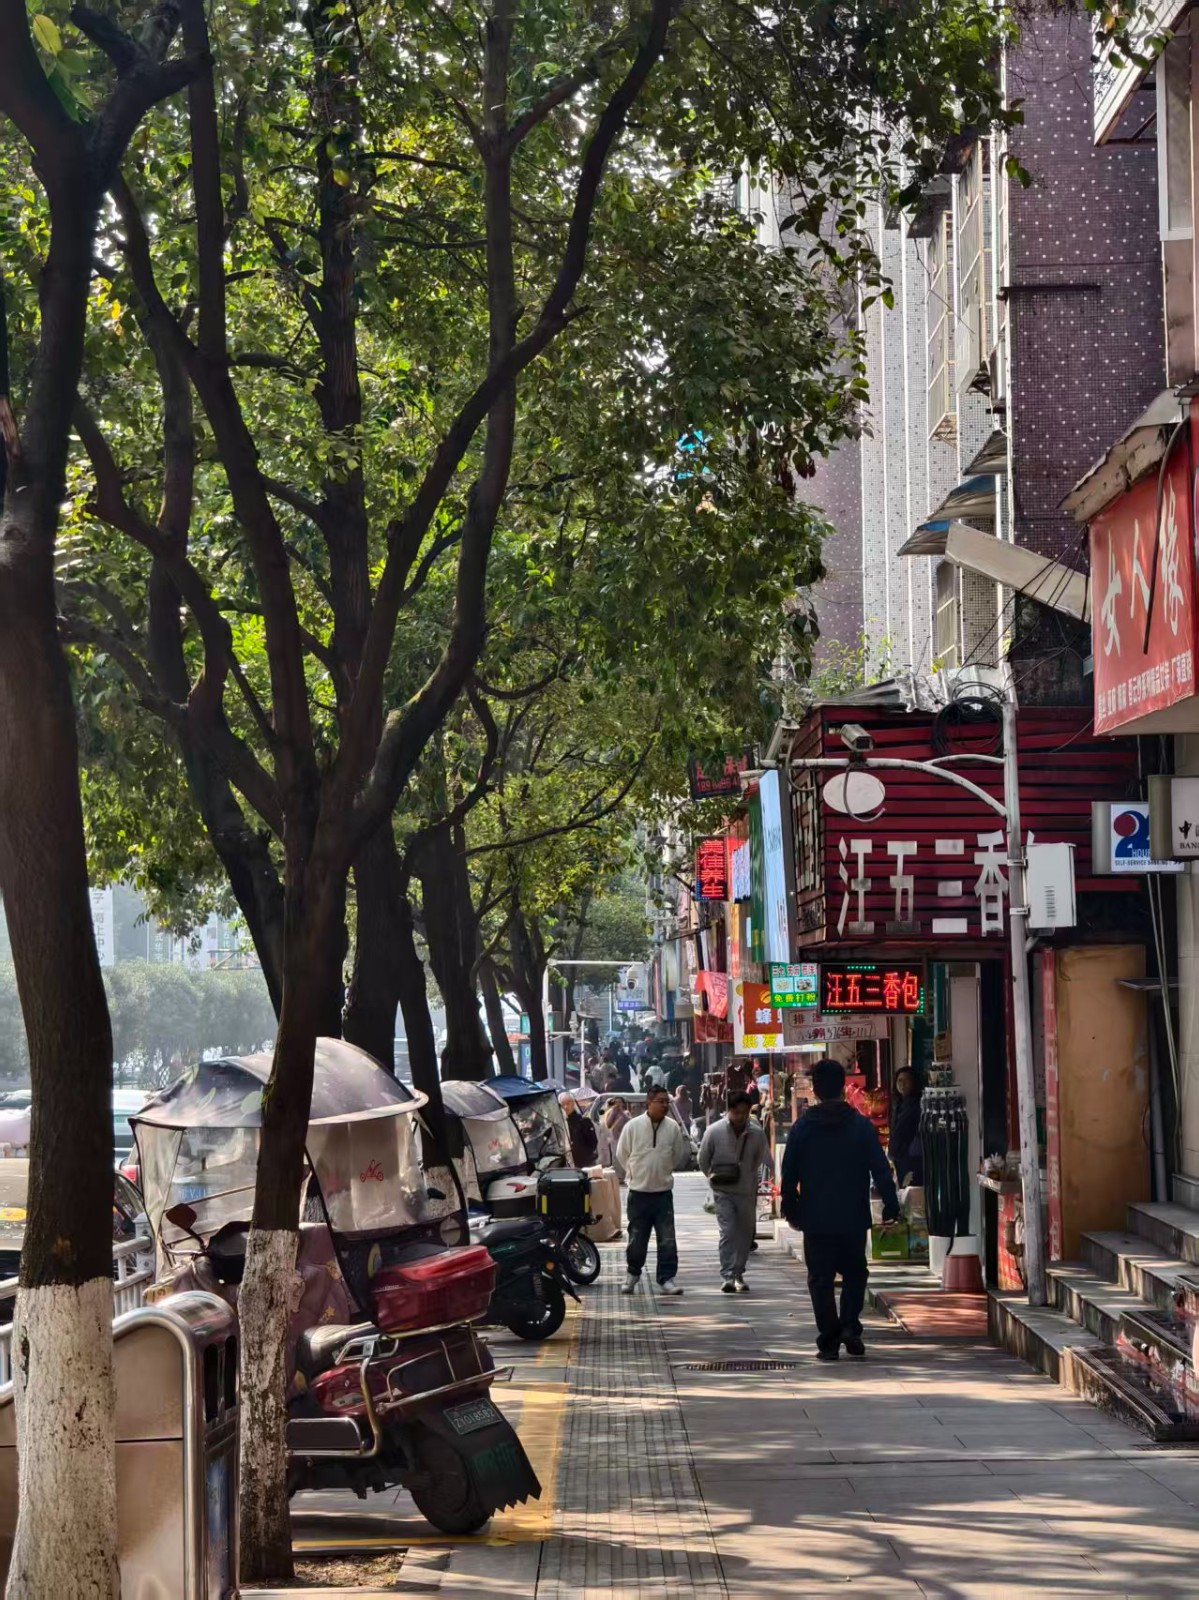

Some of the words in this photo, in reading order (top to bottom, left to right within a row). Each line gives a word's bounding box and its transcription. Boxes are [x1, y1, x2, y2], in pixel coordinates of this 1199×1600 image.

[1179, 820, 1199, 840] 中
[1179, 842, 1199, 850] BAN
[837, 829, 1035, 937] 汪五三香
[774, 993, 816, 1003] 免费打粉
[827, 971, 920, 1009] 汪五三香包
